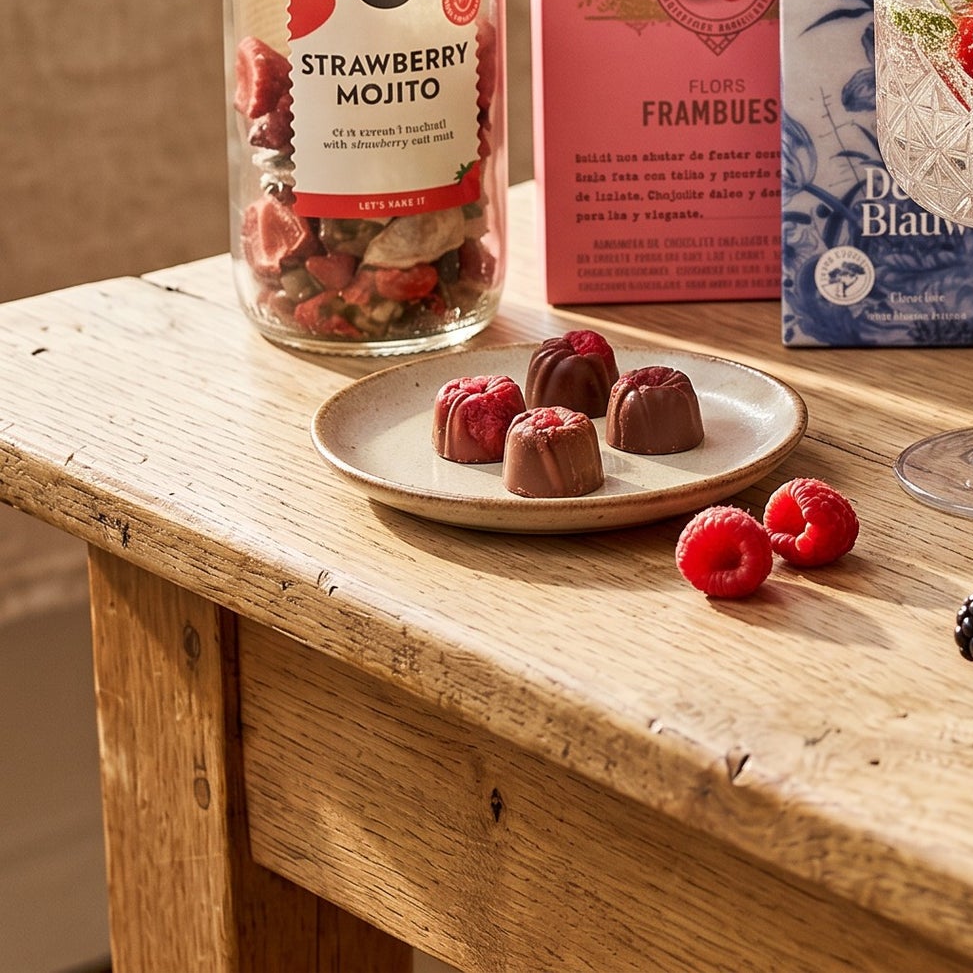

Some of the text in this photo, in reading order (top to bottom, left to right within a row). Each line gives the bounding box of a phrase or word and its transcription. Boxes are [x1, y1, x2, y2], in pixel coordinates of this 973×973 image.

[301, 41, 469, 76] STRAWBERRY
[336, 77, 441, 106] MOJITO
[689, 79, 746, 94] FLORS
[642, 98, 778, 126] FRAMBUES
[323, 139, 347, 149] with
[709, 172, 717, 182] y
[358, 201, 385, 210] LET'S
[417, 196, 425, 205] IT
[575, 192, 590, 202] de
[748, 190, 755, 201] y
[632, 212, 640, 222] y
